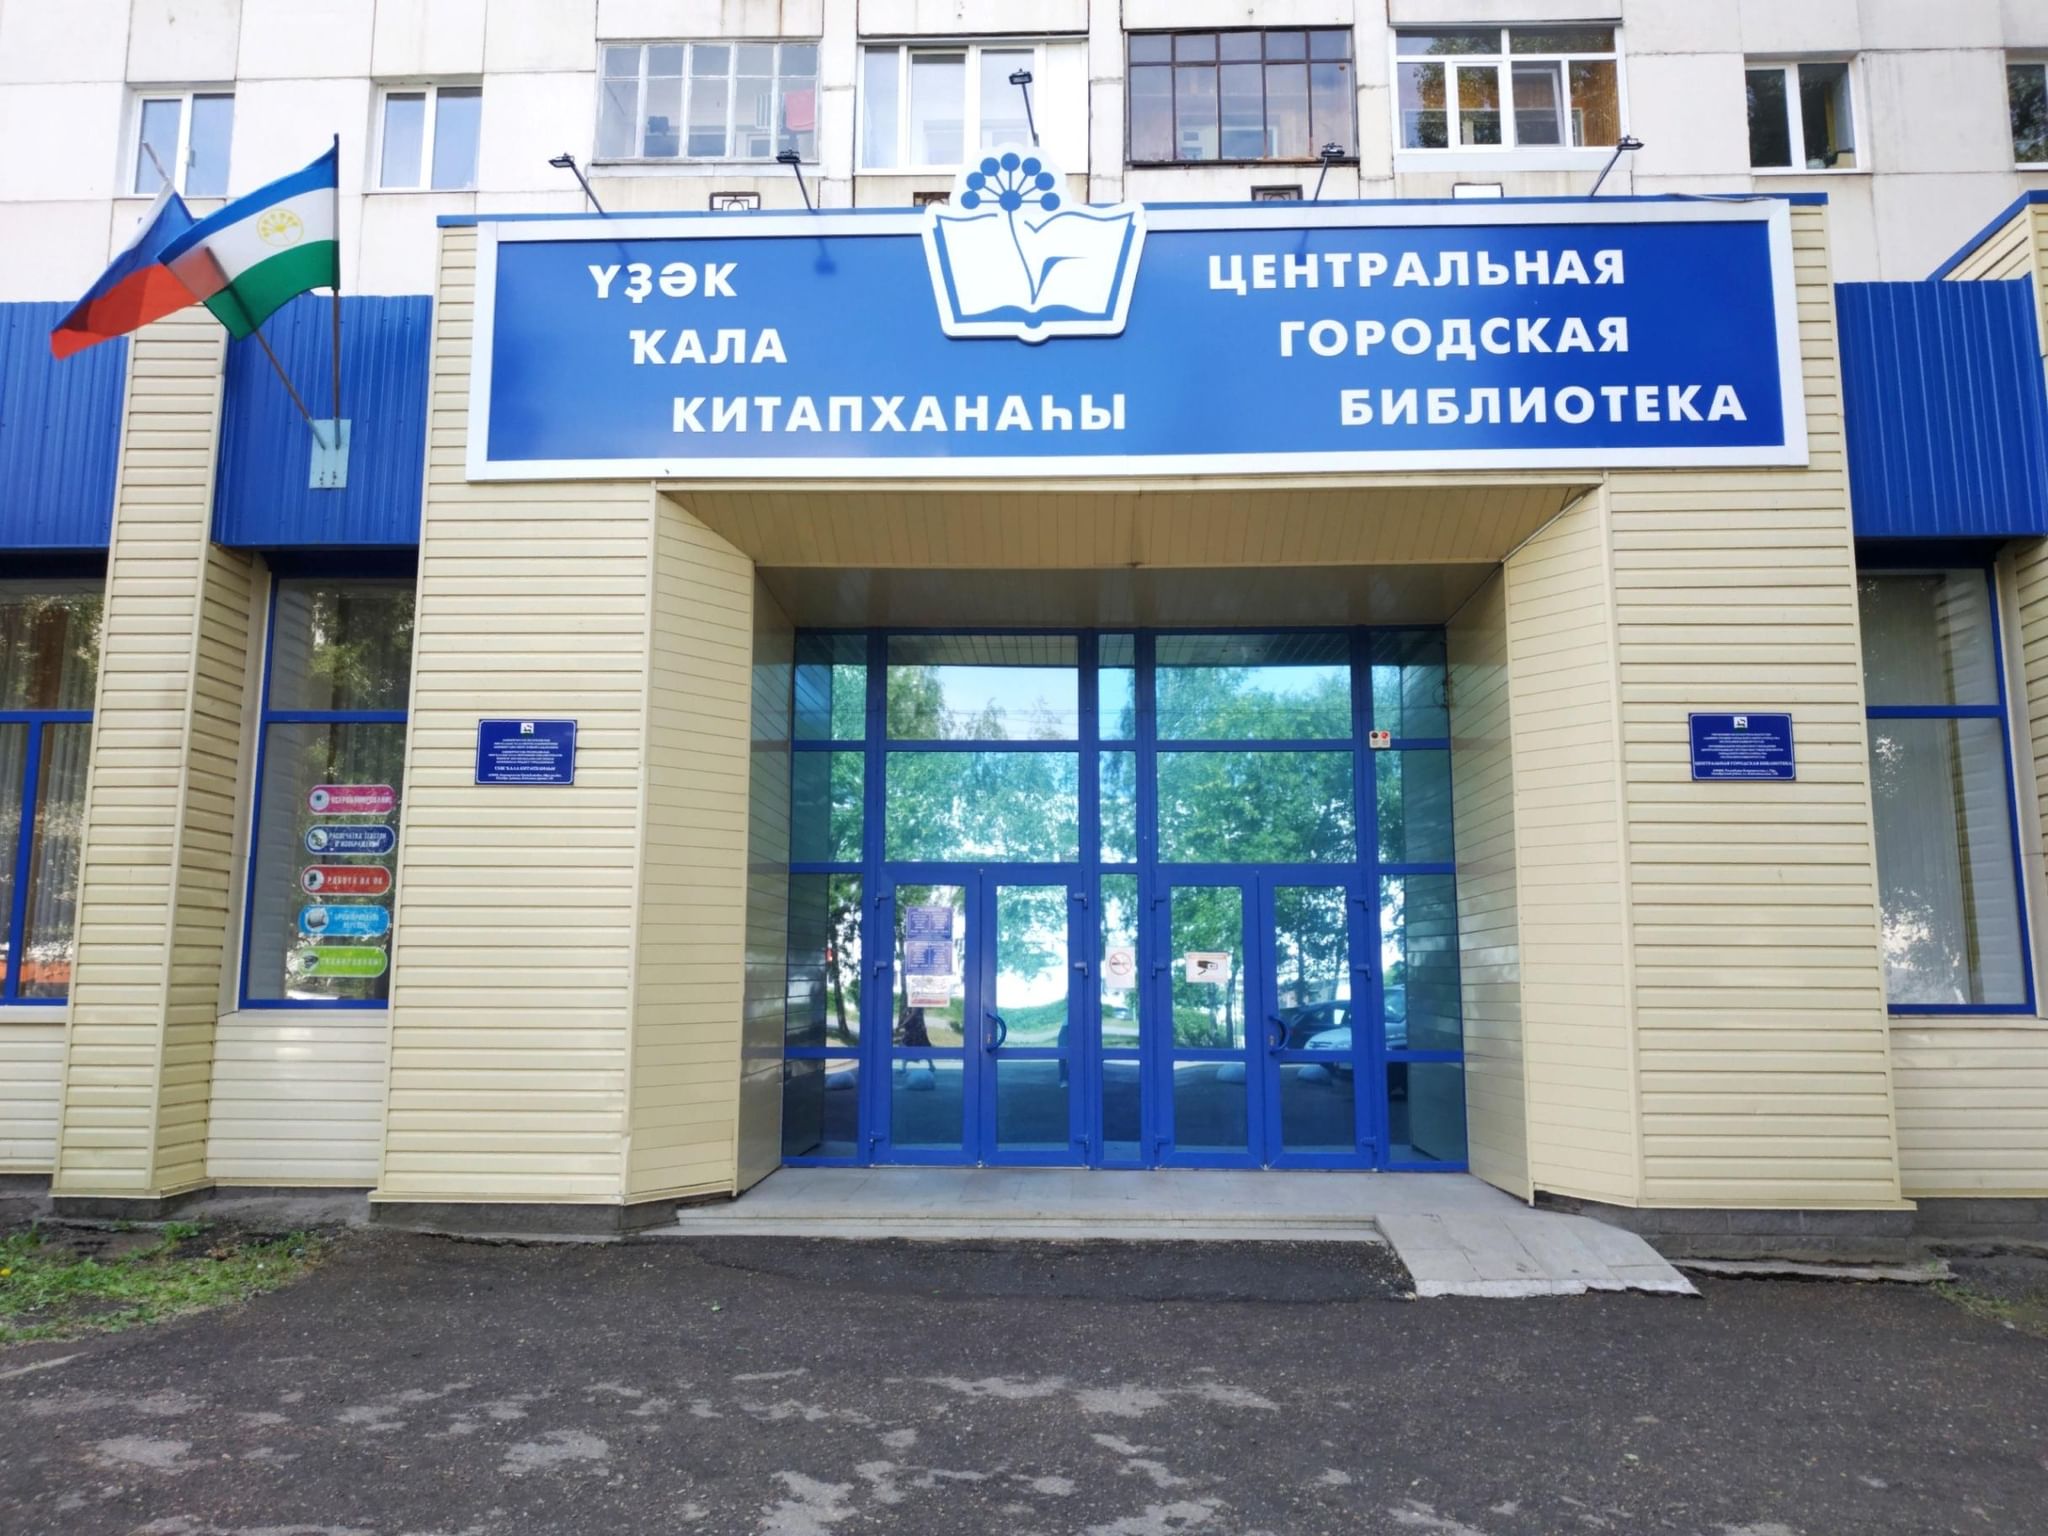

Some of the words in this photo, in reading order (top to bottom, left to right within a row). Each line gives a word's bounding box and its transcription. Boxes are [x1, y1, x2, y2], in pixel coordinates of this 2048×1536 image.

[588, 262, 738, 303] ҮҘӘК
[1208, 249, 1625, 296] ЦЕНТРАЛЬНАЯ
[629, 328, 788, 365] ҠАЛА
[1280, 316, 1630, 362] ГОРОДСКАЯ
[672, 393, 1127, 433] КИТАПХАНАҺЫ
[1340, 384, 1748, 426] БИБЛИОТЕКА
